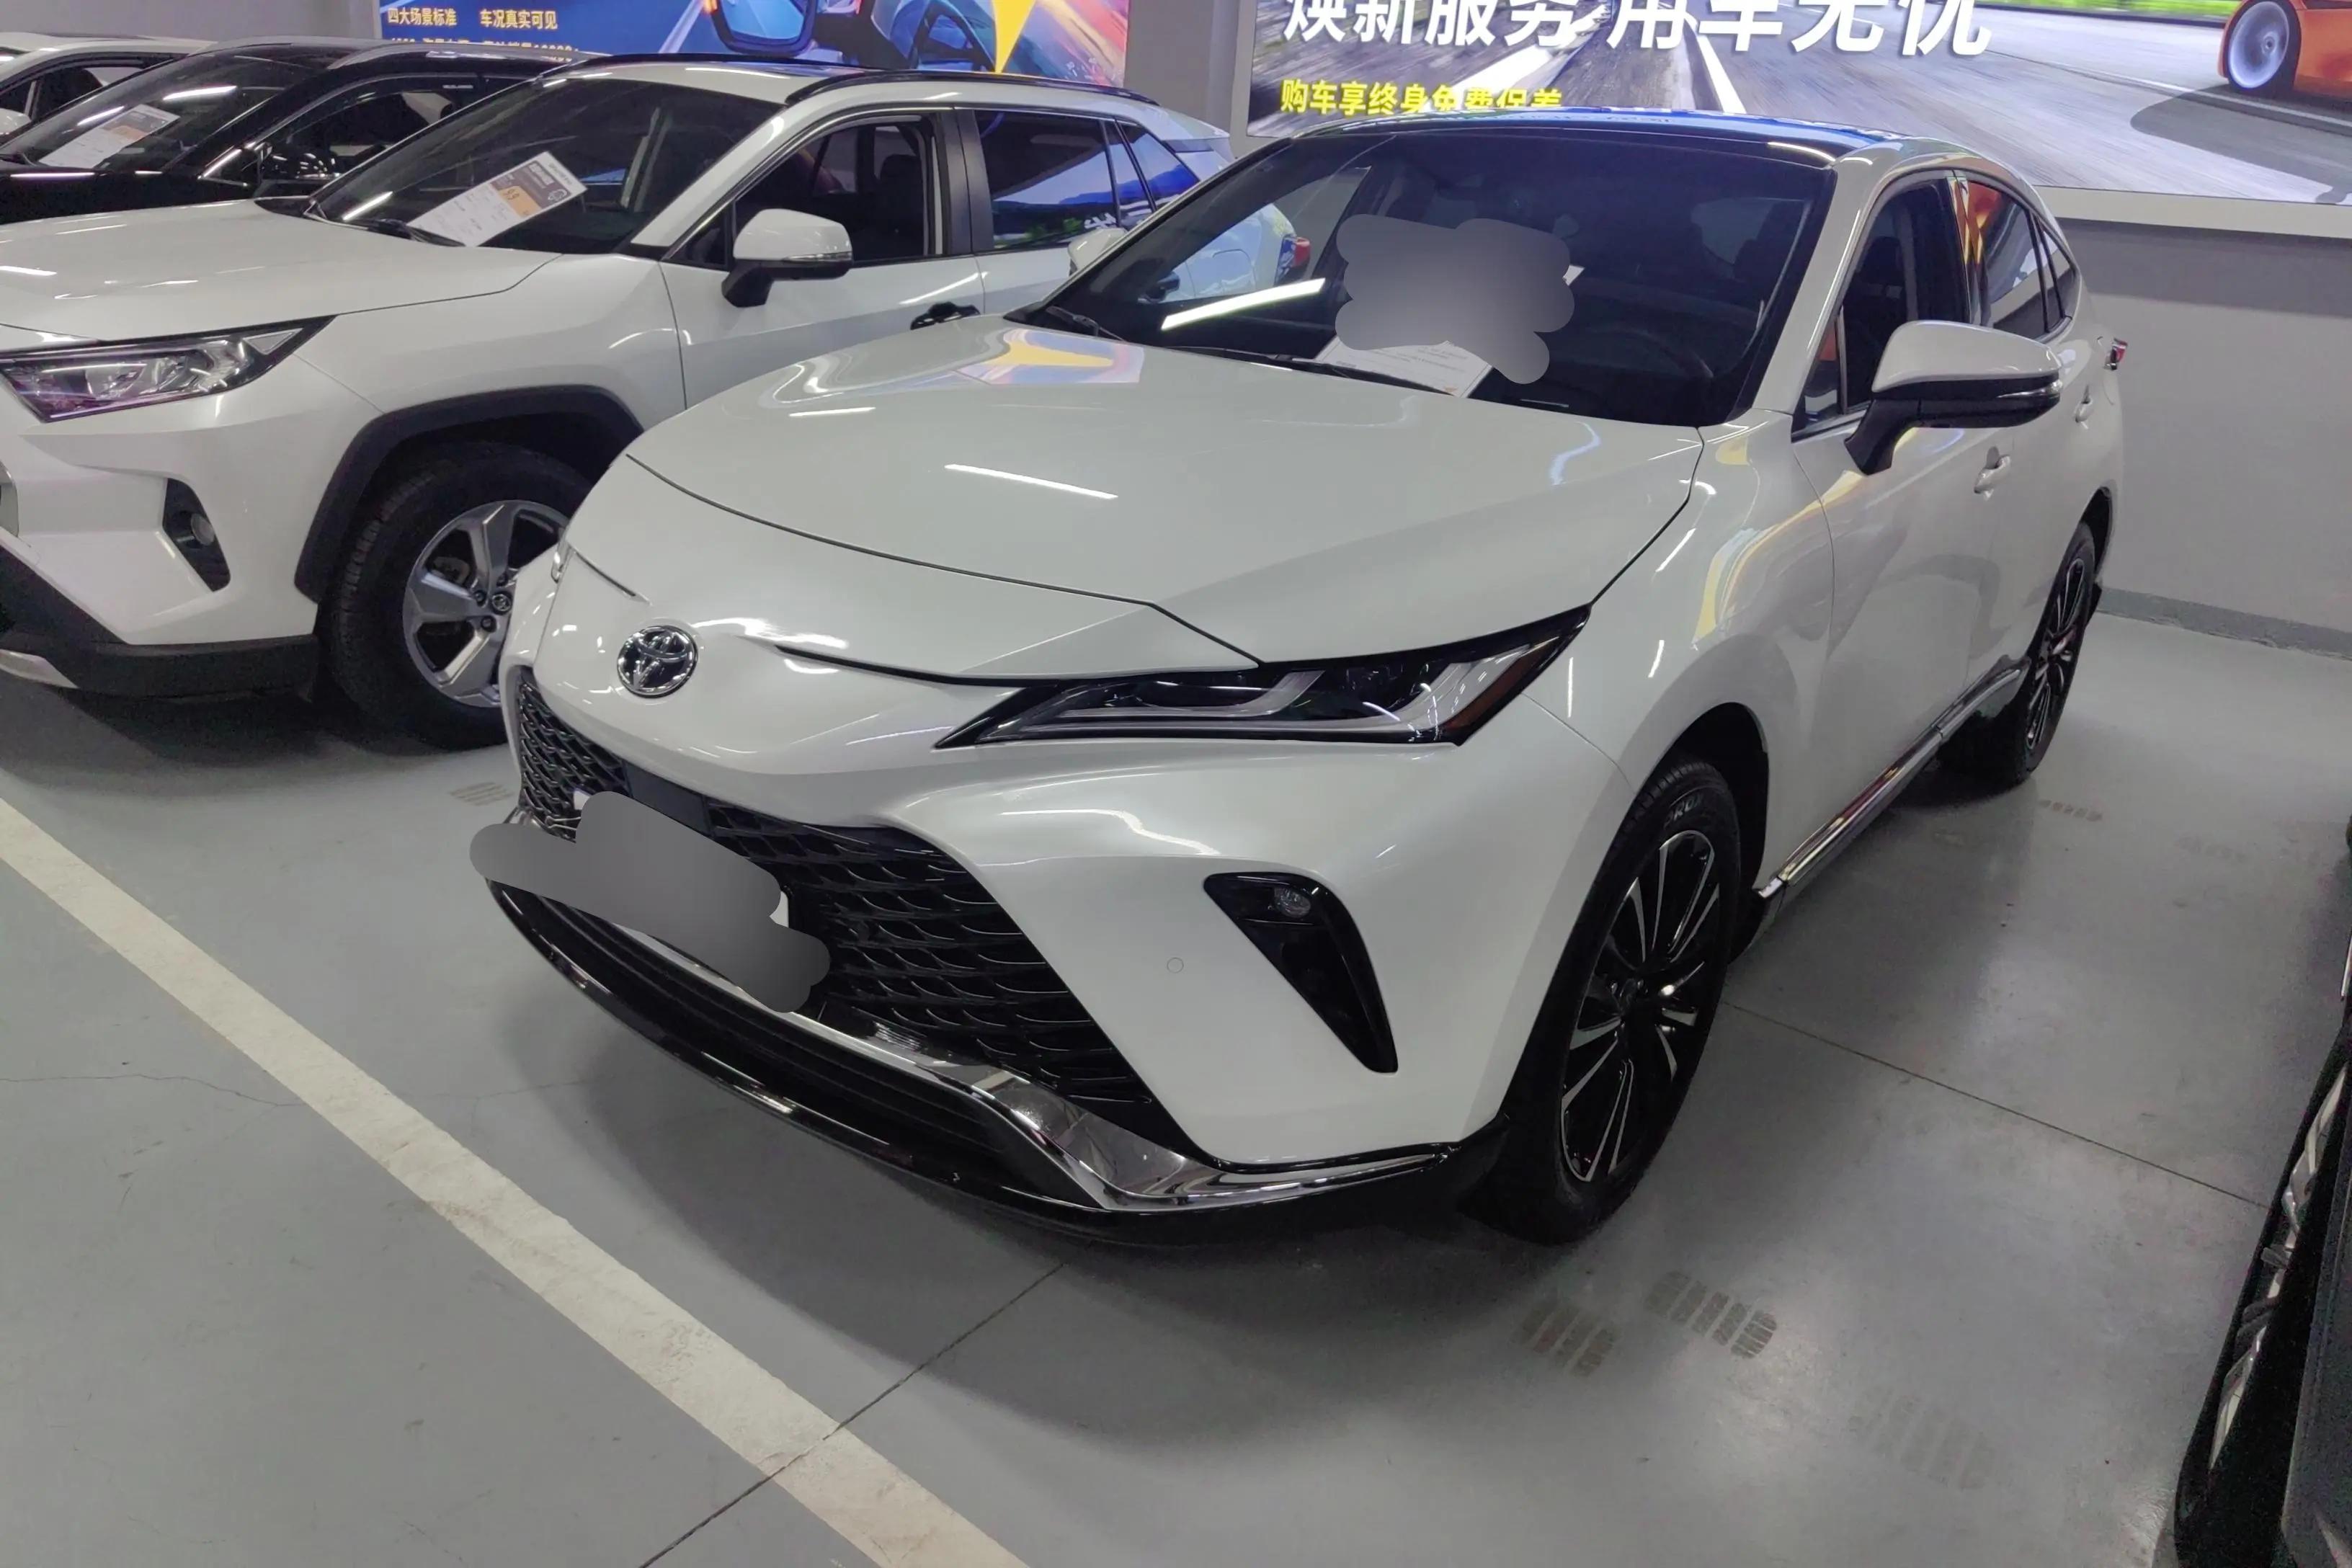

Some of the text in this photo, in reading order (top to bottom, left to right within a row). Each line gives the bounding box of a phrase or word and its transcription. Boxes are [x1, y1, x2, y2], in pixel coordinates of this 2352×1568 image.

[388, 7, 558, 30] 四大场景标准 车况真实可见
